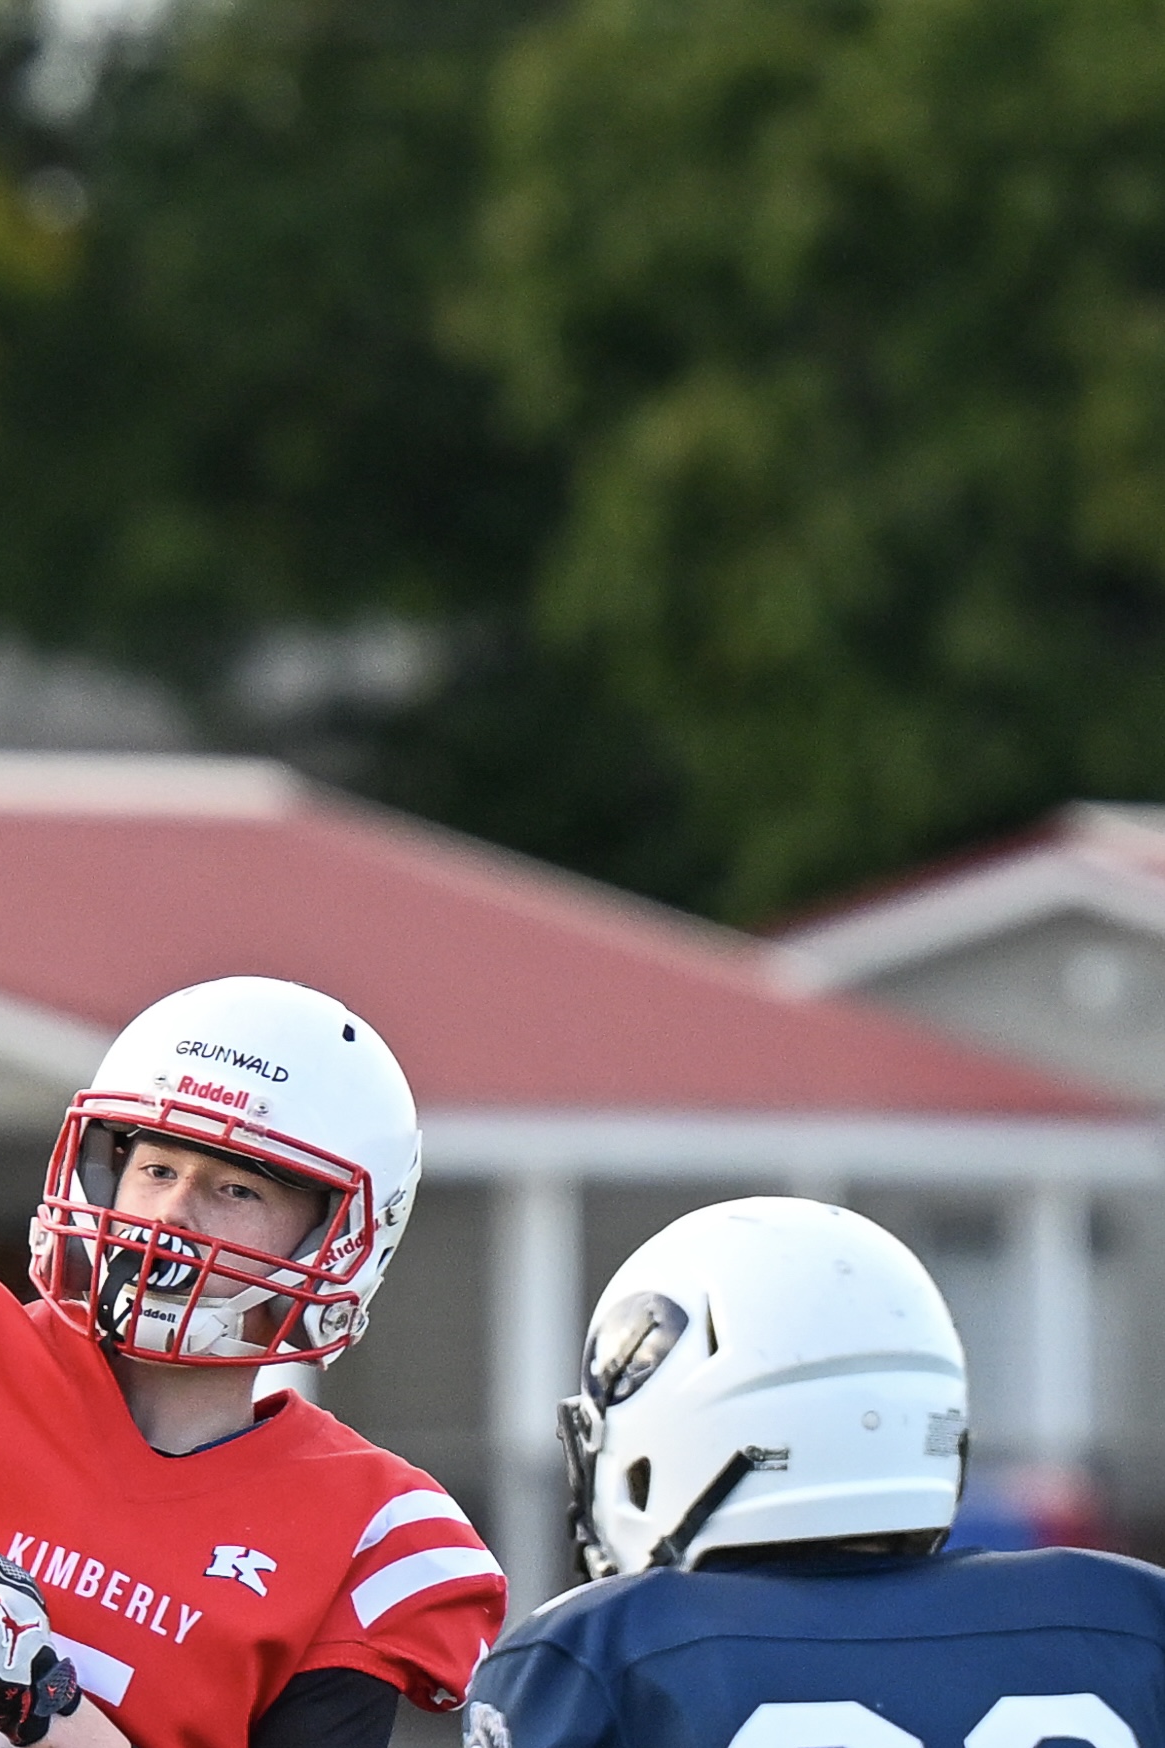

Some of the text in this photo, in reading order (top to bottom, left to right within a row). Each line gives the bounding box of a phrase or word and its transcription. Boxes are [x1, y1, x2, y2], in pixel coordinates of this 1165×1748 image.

[175, 1040, 290, 1083] GRUNWALD
[176, 1074, 250, 1110] Riddell
[6, 1531, 203, 1645] KIMBERLY
[203, 1544, 278, 1598] K
